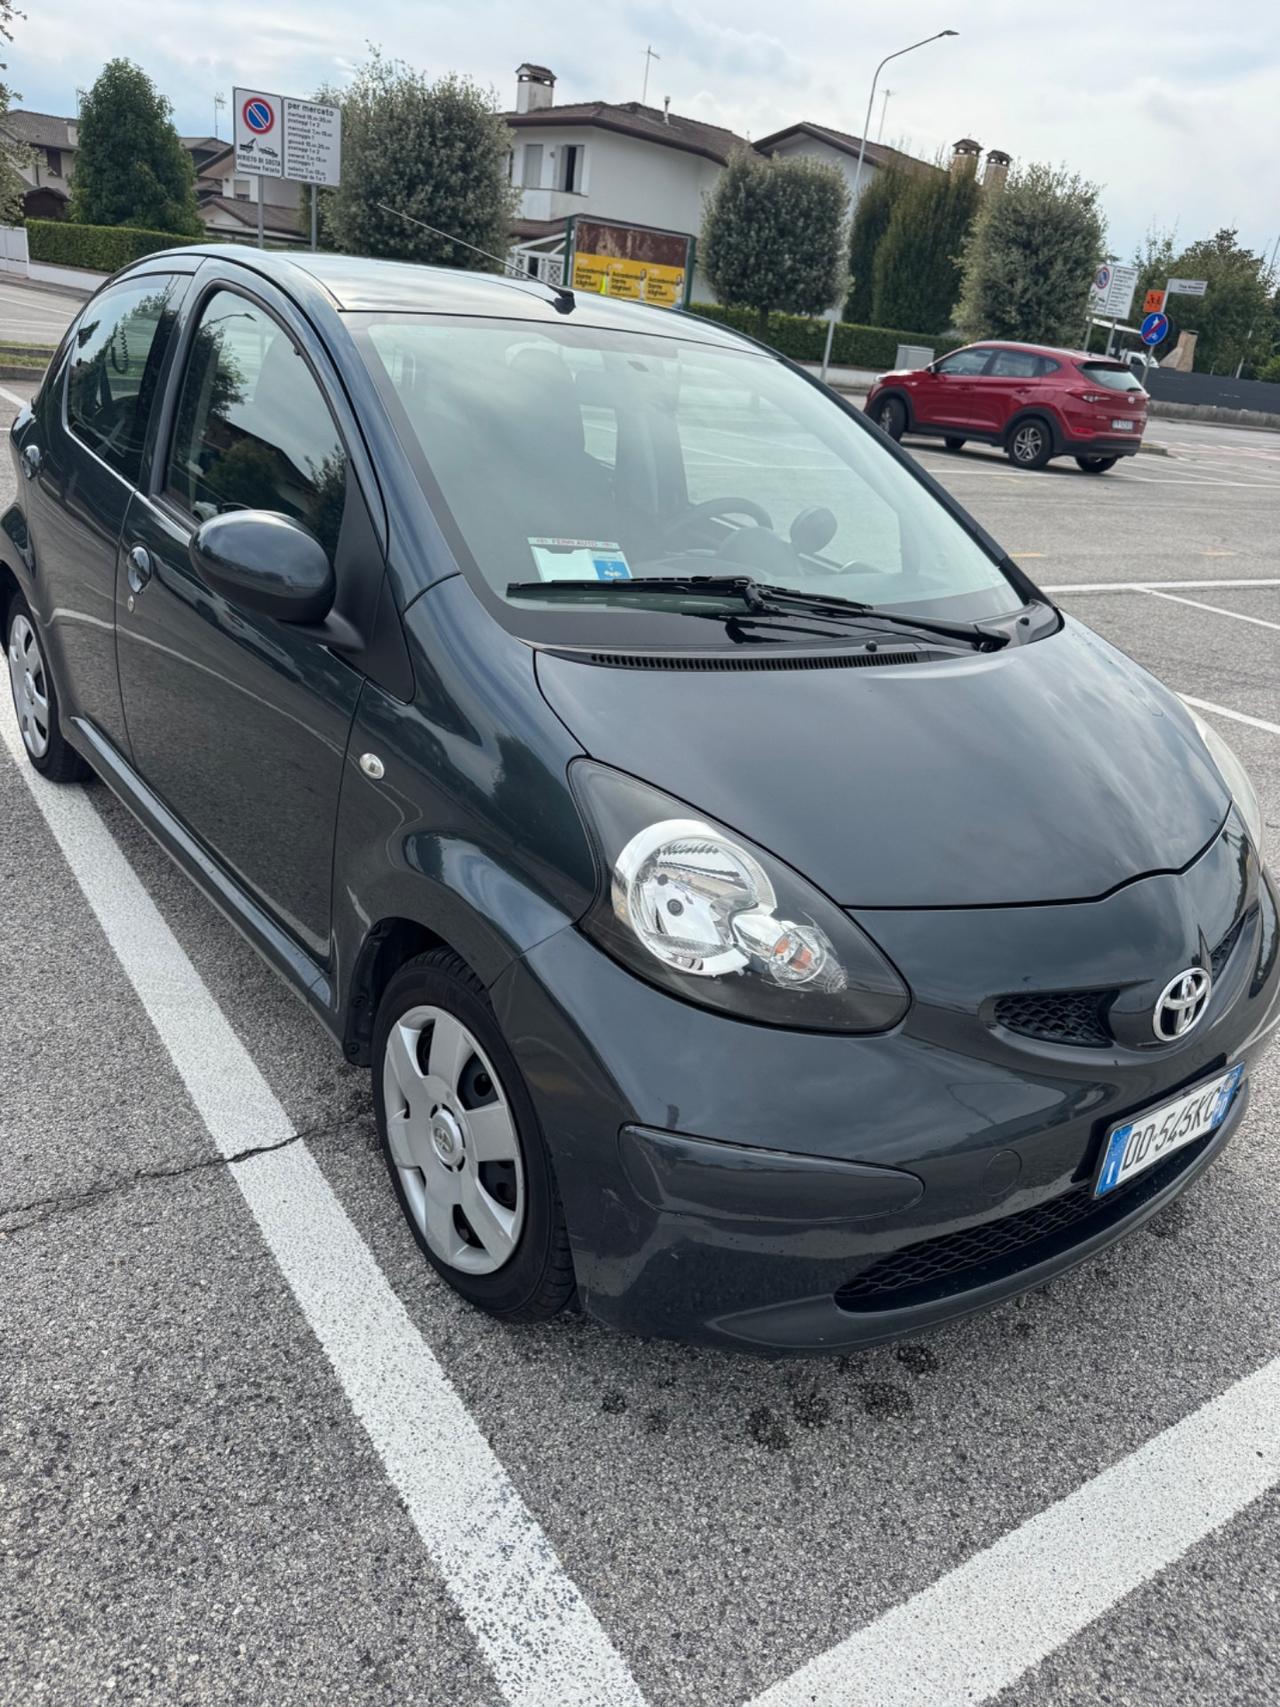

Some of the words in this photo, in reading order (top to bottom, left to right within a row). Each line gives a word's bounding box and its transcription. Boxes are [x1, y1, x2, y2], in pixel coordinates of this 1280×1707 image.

[288, 102, 300, 111] per
[302, 105, 334, 117] mercato
[265, 158, 280, 167] SOSTA
